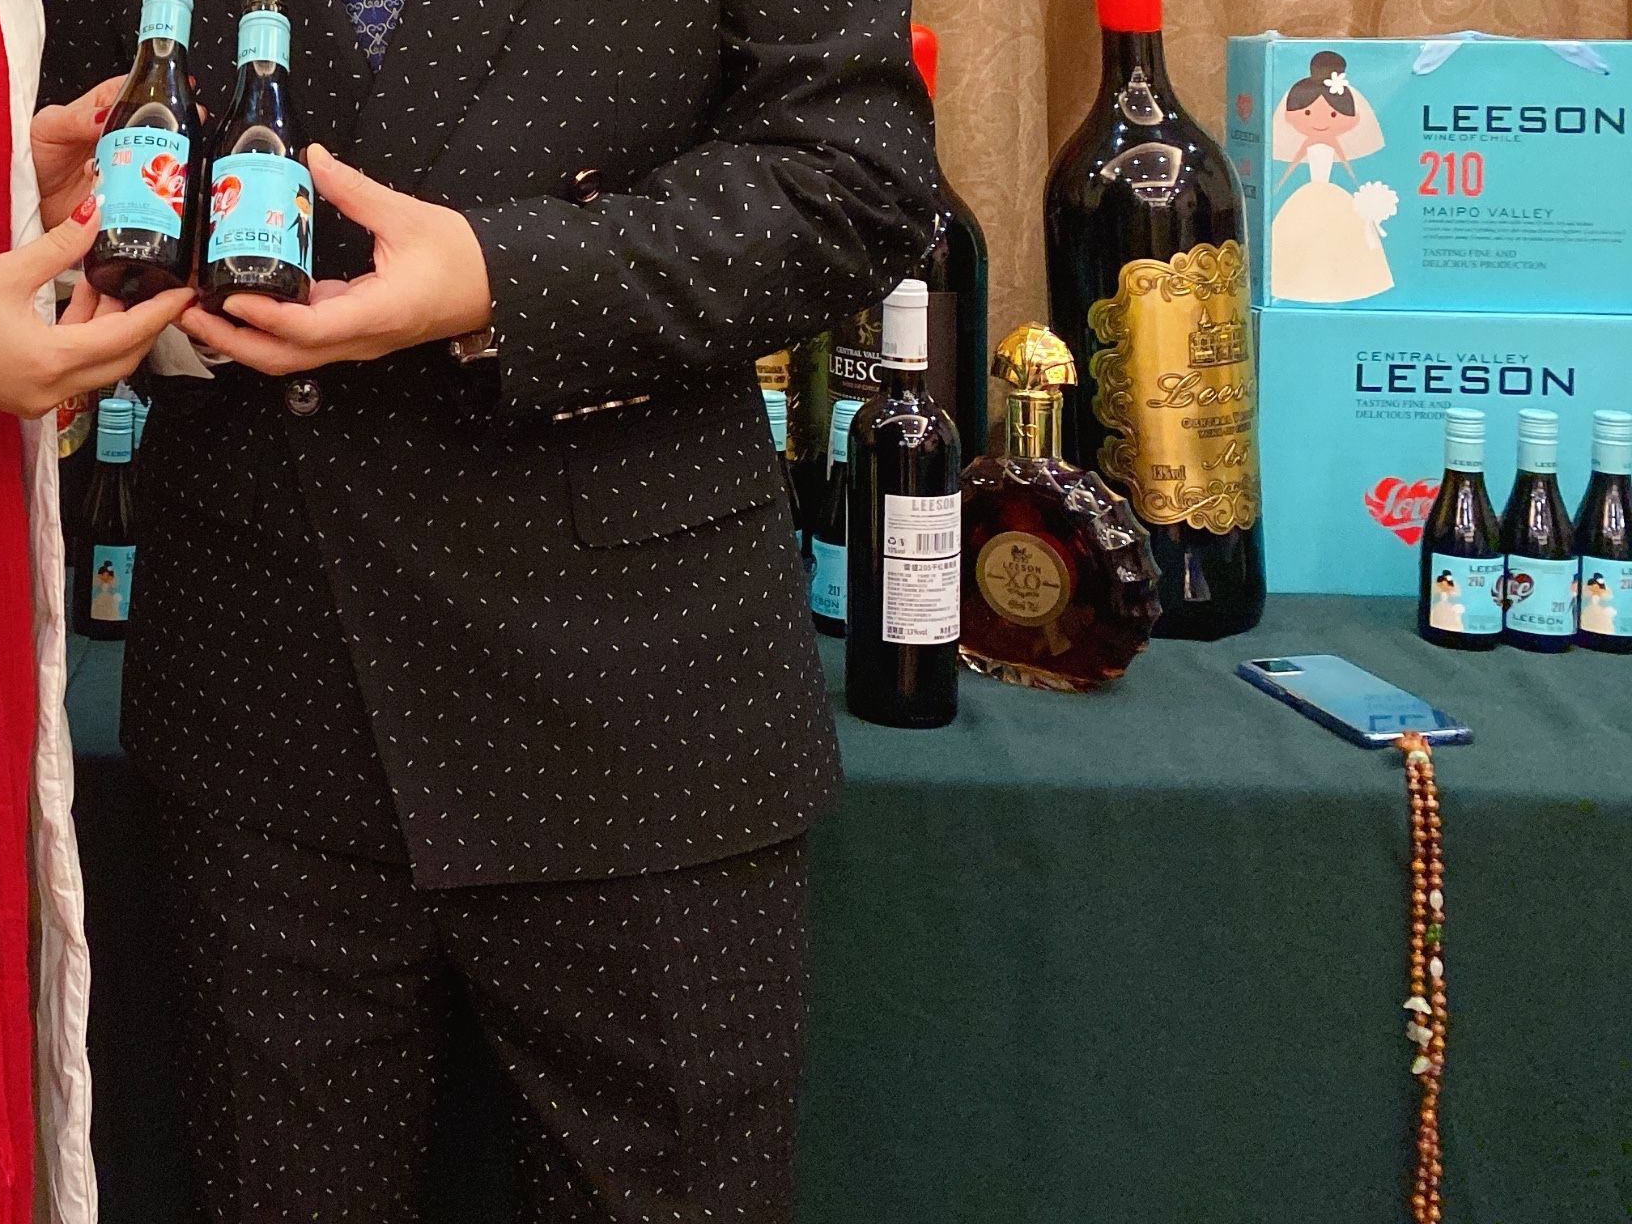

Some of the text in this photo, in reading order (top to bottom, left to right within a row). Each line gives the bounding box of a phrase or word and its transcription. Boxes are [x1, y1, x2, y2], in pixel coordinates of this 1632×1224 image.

[1423, 105, 1626, 135] LEESON
[114, 135, 180, 151] LEESON
[1423, 133, 1455, 142] WINE
[1479, 134, 1522, 143] CHILE
[1418, 151, 1484, 196] 210
[1423, 207, 1554, 219] MAIPO VALLEY
[215, 231, 283, 247] LEESON
[863, 351, 883, 360] VALL
[1357, 350, 1529, 364] CENTRAL VALLEY
[828, 353, 883, 383] LEESO
[1356, 363, 1575, 397] LEESON
[911, 498, 955, 512] LEESON
